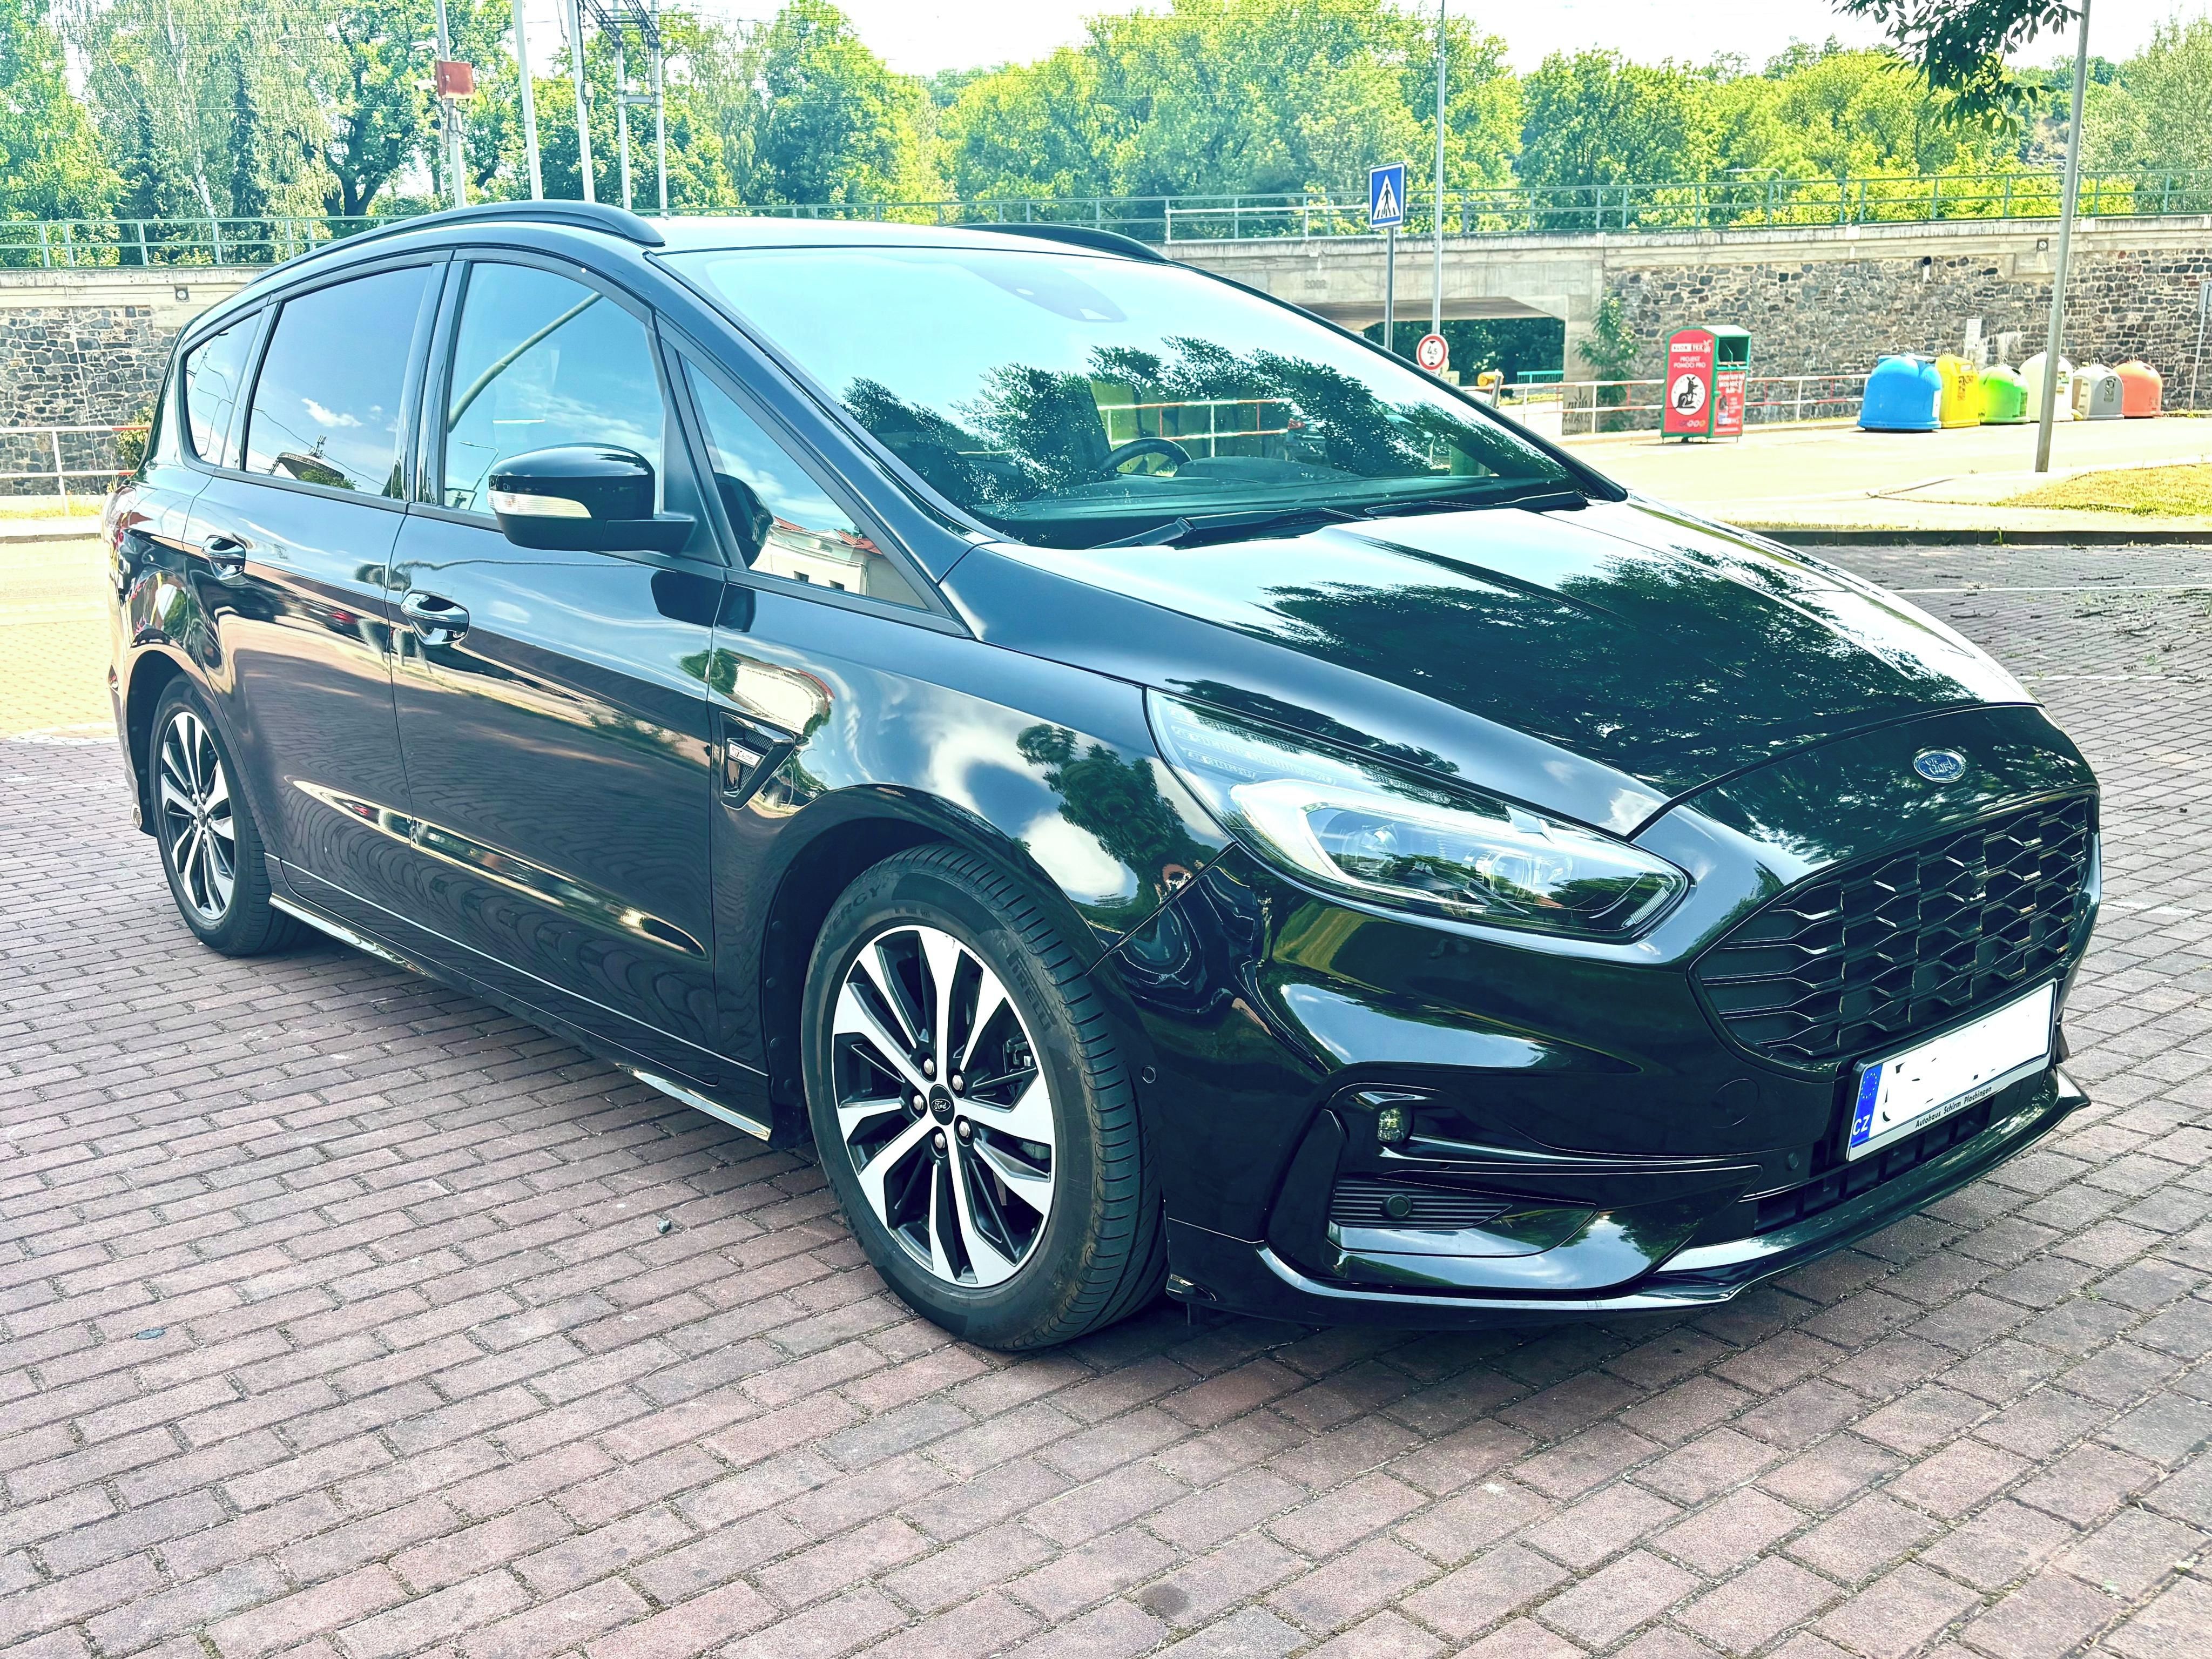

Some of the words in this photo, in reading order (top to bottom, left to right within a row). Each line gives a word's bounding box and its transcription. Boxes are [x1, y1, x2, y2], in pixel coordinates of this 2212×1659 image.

[1925, 756, 1956, 775] Ford
[1006, 949, 1058, 1031] PIRELLI
[1915, 1111, 1941, 1129] Autohaus
[1944, 1101, 1961, 1114] Schirm
[1964, 1087, 1992, 1104] Plochingen
[1852, 1114, 1871, 1136] CZ
